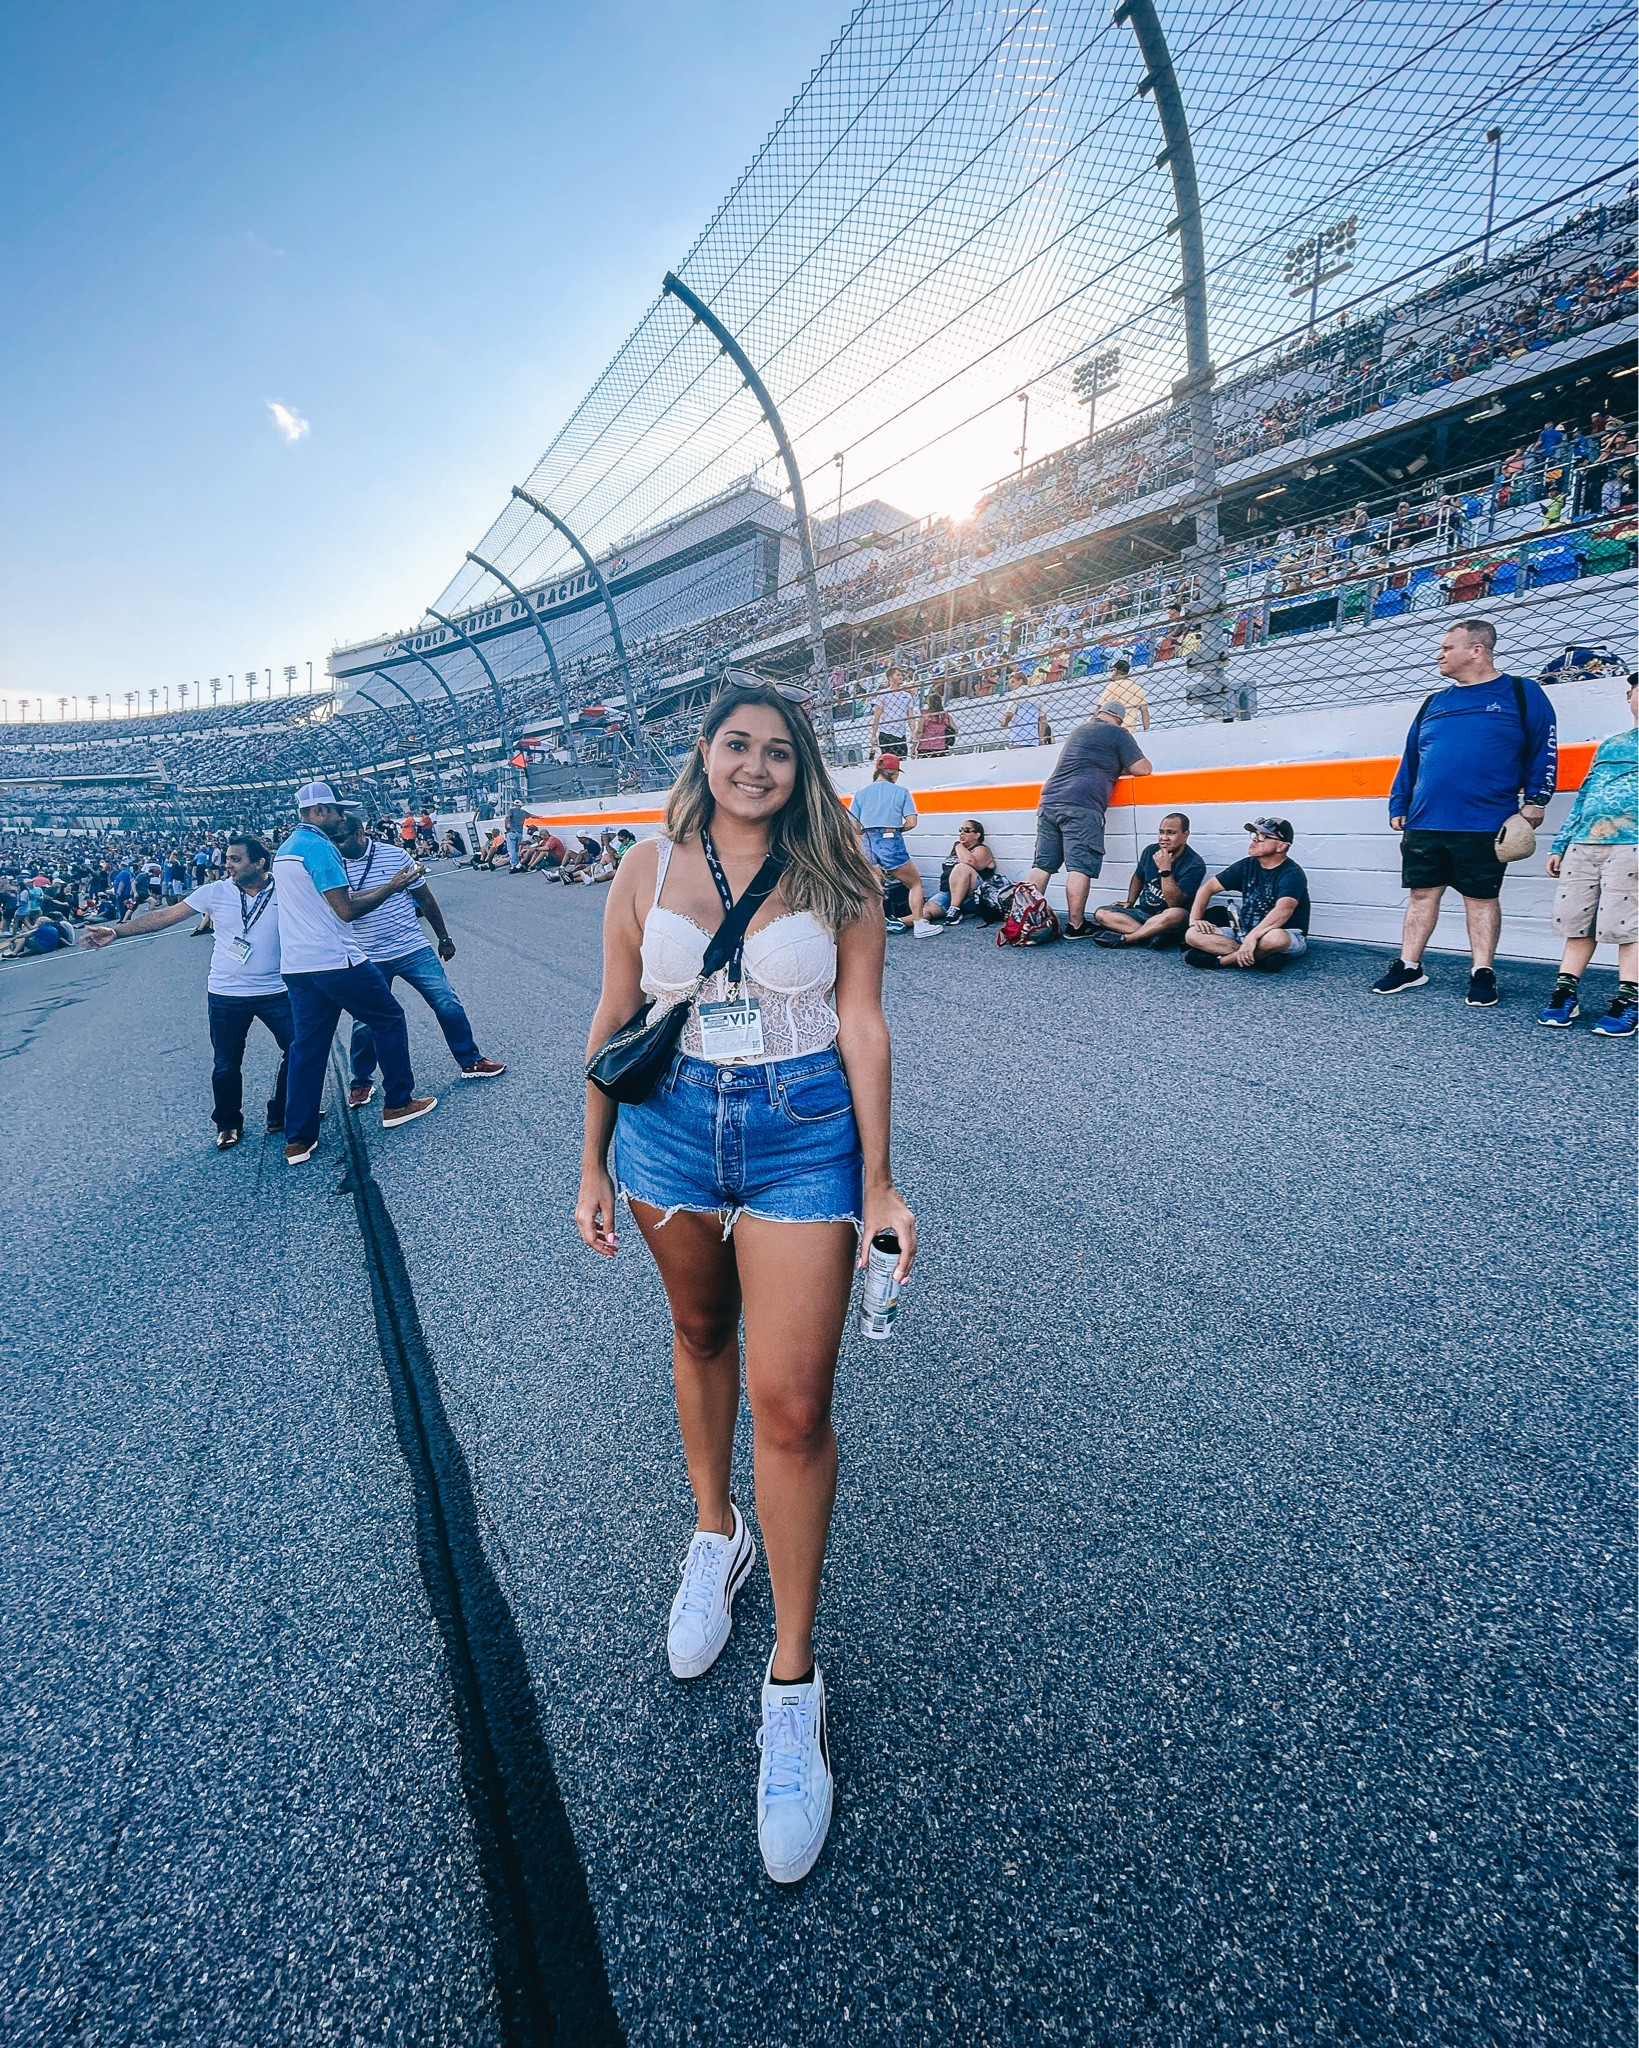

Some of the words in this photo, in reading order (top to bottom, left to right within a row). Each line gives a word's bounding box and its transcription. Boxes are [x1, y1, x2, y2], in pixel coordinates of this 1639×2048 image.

[406, 630, 446, 649] WORLD
[453, 608, 502, 636] ENTER
[537, 573, 597, 608] RACING
[729, 1012, 757, 1025] VIP
